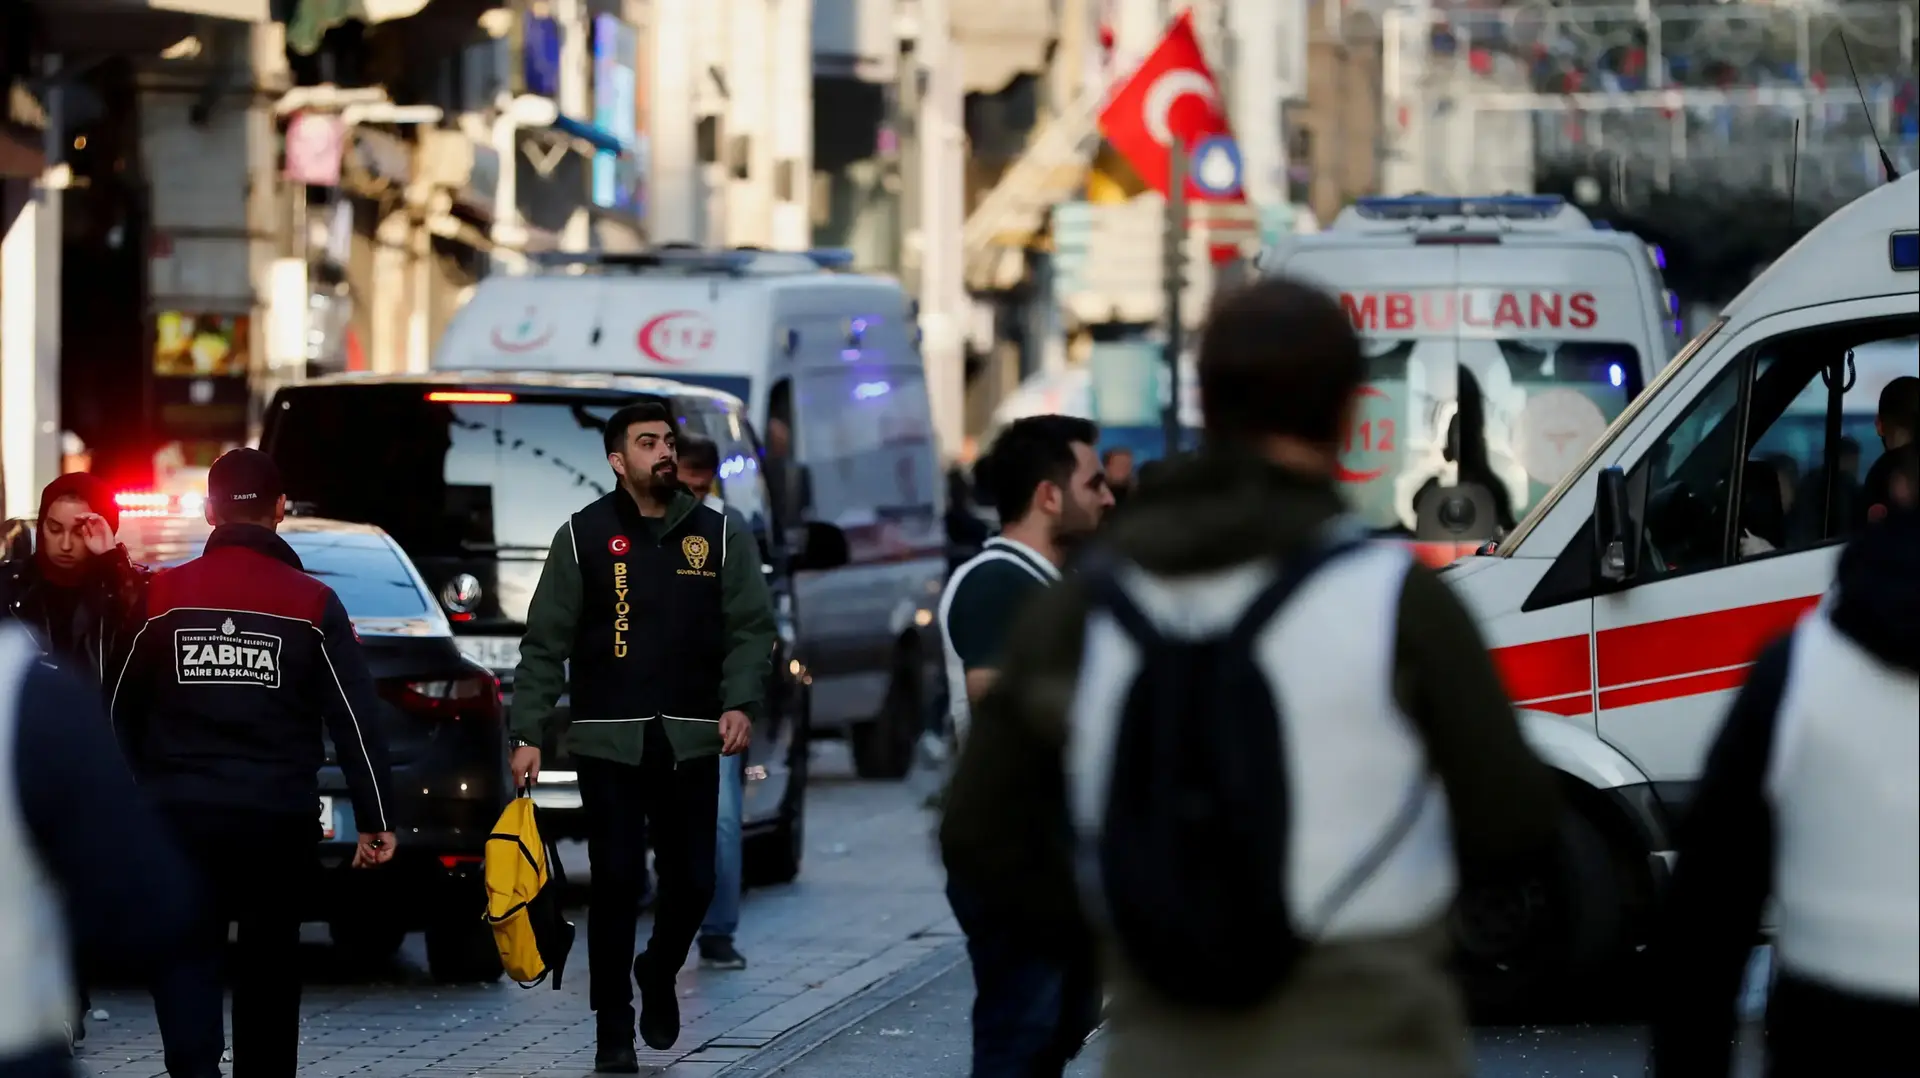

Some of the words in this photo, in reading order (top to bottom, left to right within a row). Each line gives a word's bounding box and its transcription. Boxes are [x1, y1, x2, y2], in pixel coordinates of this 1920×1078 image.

[1339, 292, 1599, 330] MBULANS
[614, 562, 630, 657] BEYOĞLU
[182, 644, 274, 671] ZABITA
[184, 667, 212, 676] DAİRE
